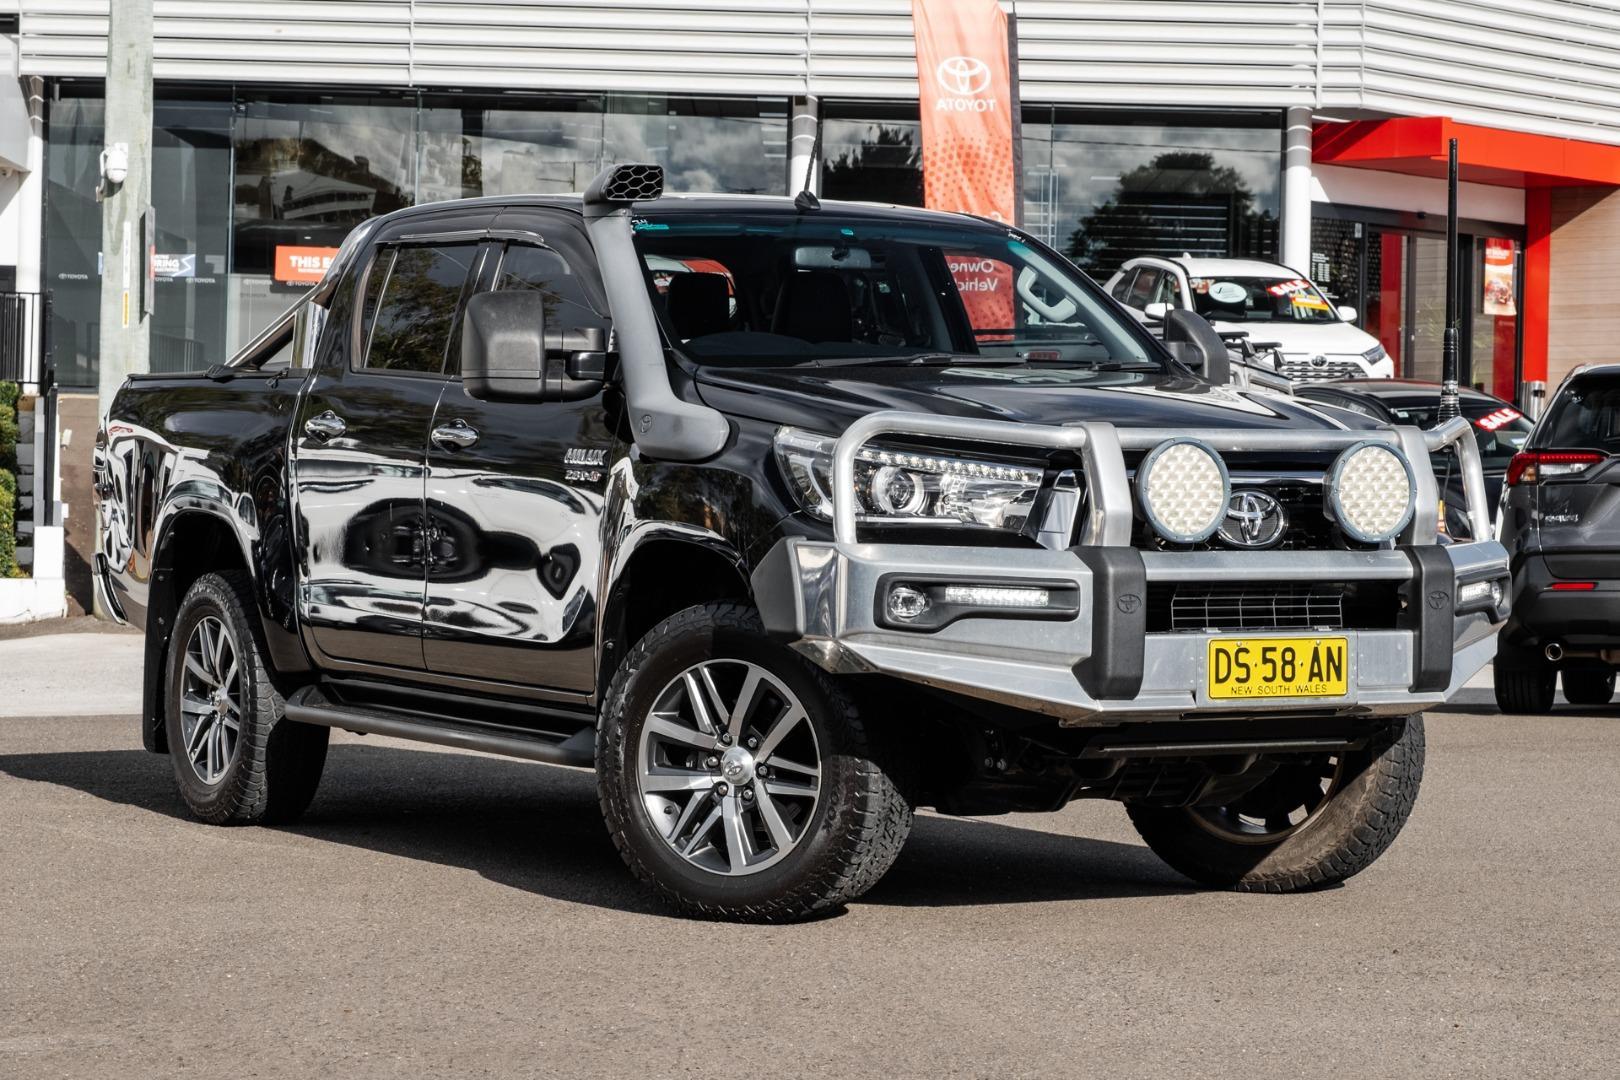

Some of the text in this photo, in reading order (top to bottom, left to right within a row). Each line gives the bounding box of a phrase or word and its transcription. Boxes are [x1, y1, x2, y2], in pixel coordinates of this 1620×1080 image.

[1479, 407, 1521, 430] SALE
[564, 448, 607, 466] HILUX
[1230, 683, 1327, 695] NEW SOUTH WALES
